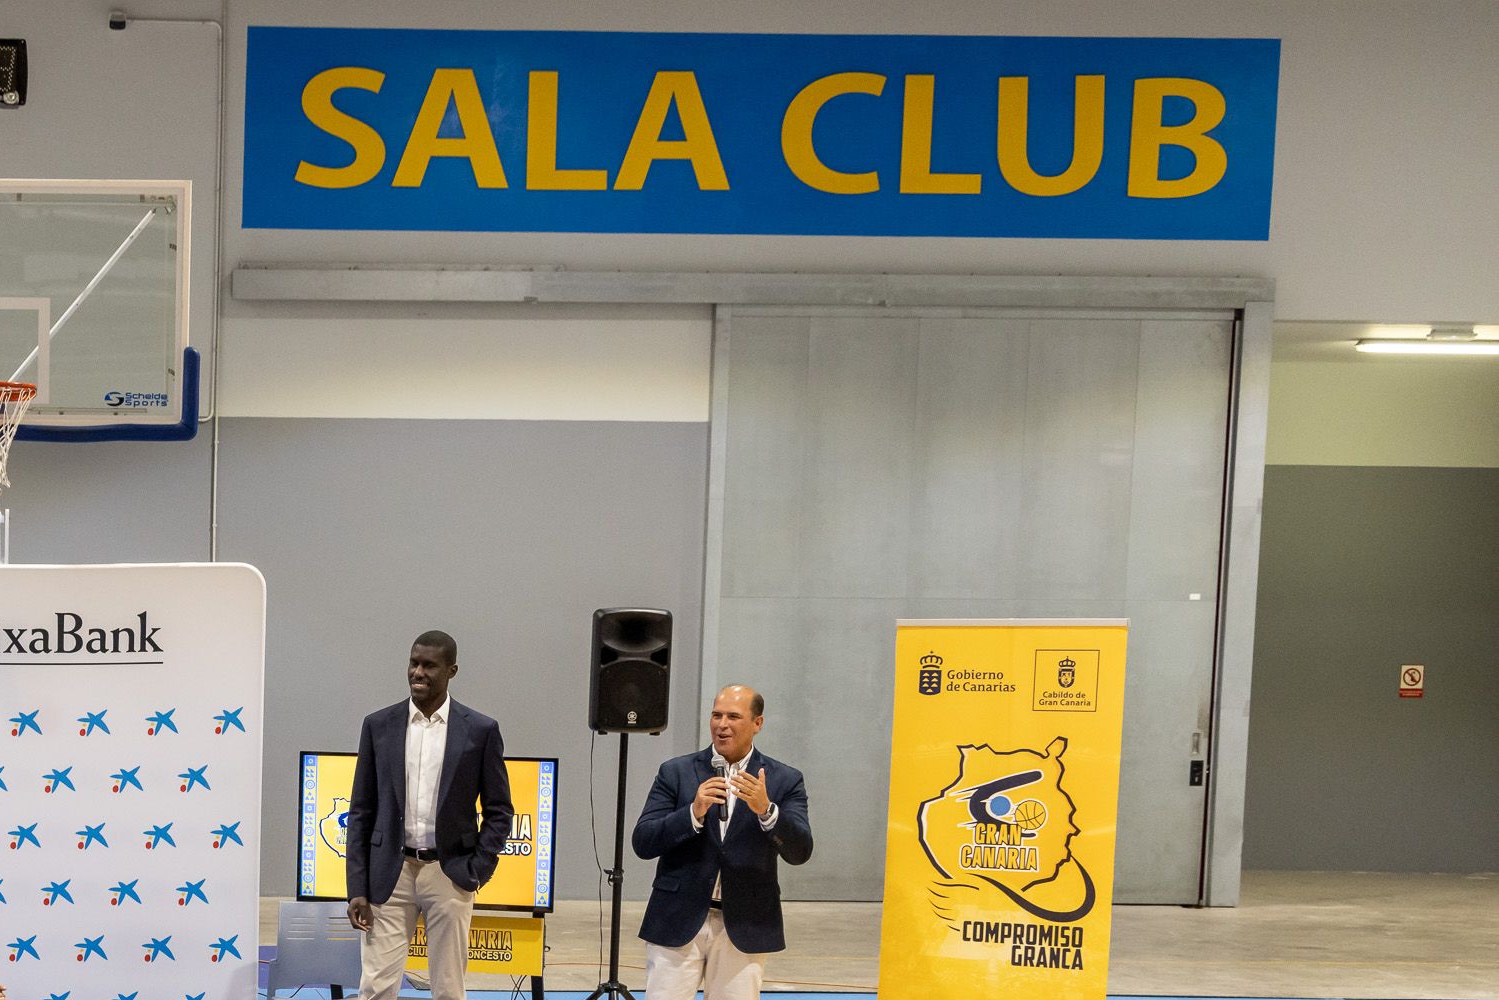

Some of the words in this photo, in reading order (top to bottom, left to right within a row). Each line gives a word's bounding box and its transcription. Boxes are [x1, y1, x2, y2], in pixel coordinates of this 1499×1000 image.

[294, 66, 730, 191] SALA
[779, 71, 1229, 199] CLUB
[124, 400, 169, 408] Sports
[946, 669, 1004, 681] Gobierno
[946, 681, 960, 692] de
[962, 682, 1016, 693] Canarias
[1042, 690, 1074, 699] Cabildo
[1078, 691, 1086, 699] de
[1038, 699, 1058, 707] Gran
[1060, 699, 1092, 707] Canaria
[974, 822, 1022, 846] GRAN
[960, 844, 1038, 871] CANARIA
[962, 920, 1084, 949] COMPROMISO
[1011, 945, 1084, 971] GRANCA
